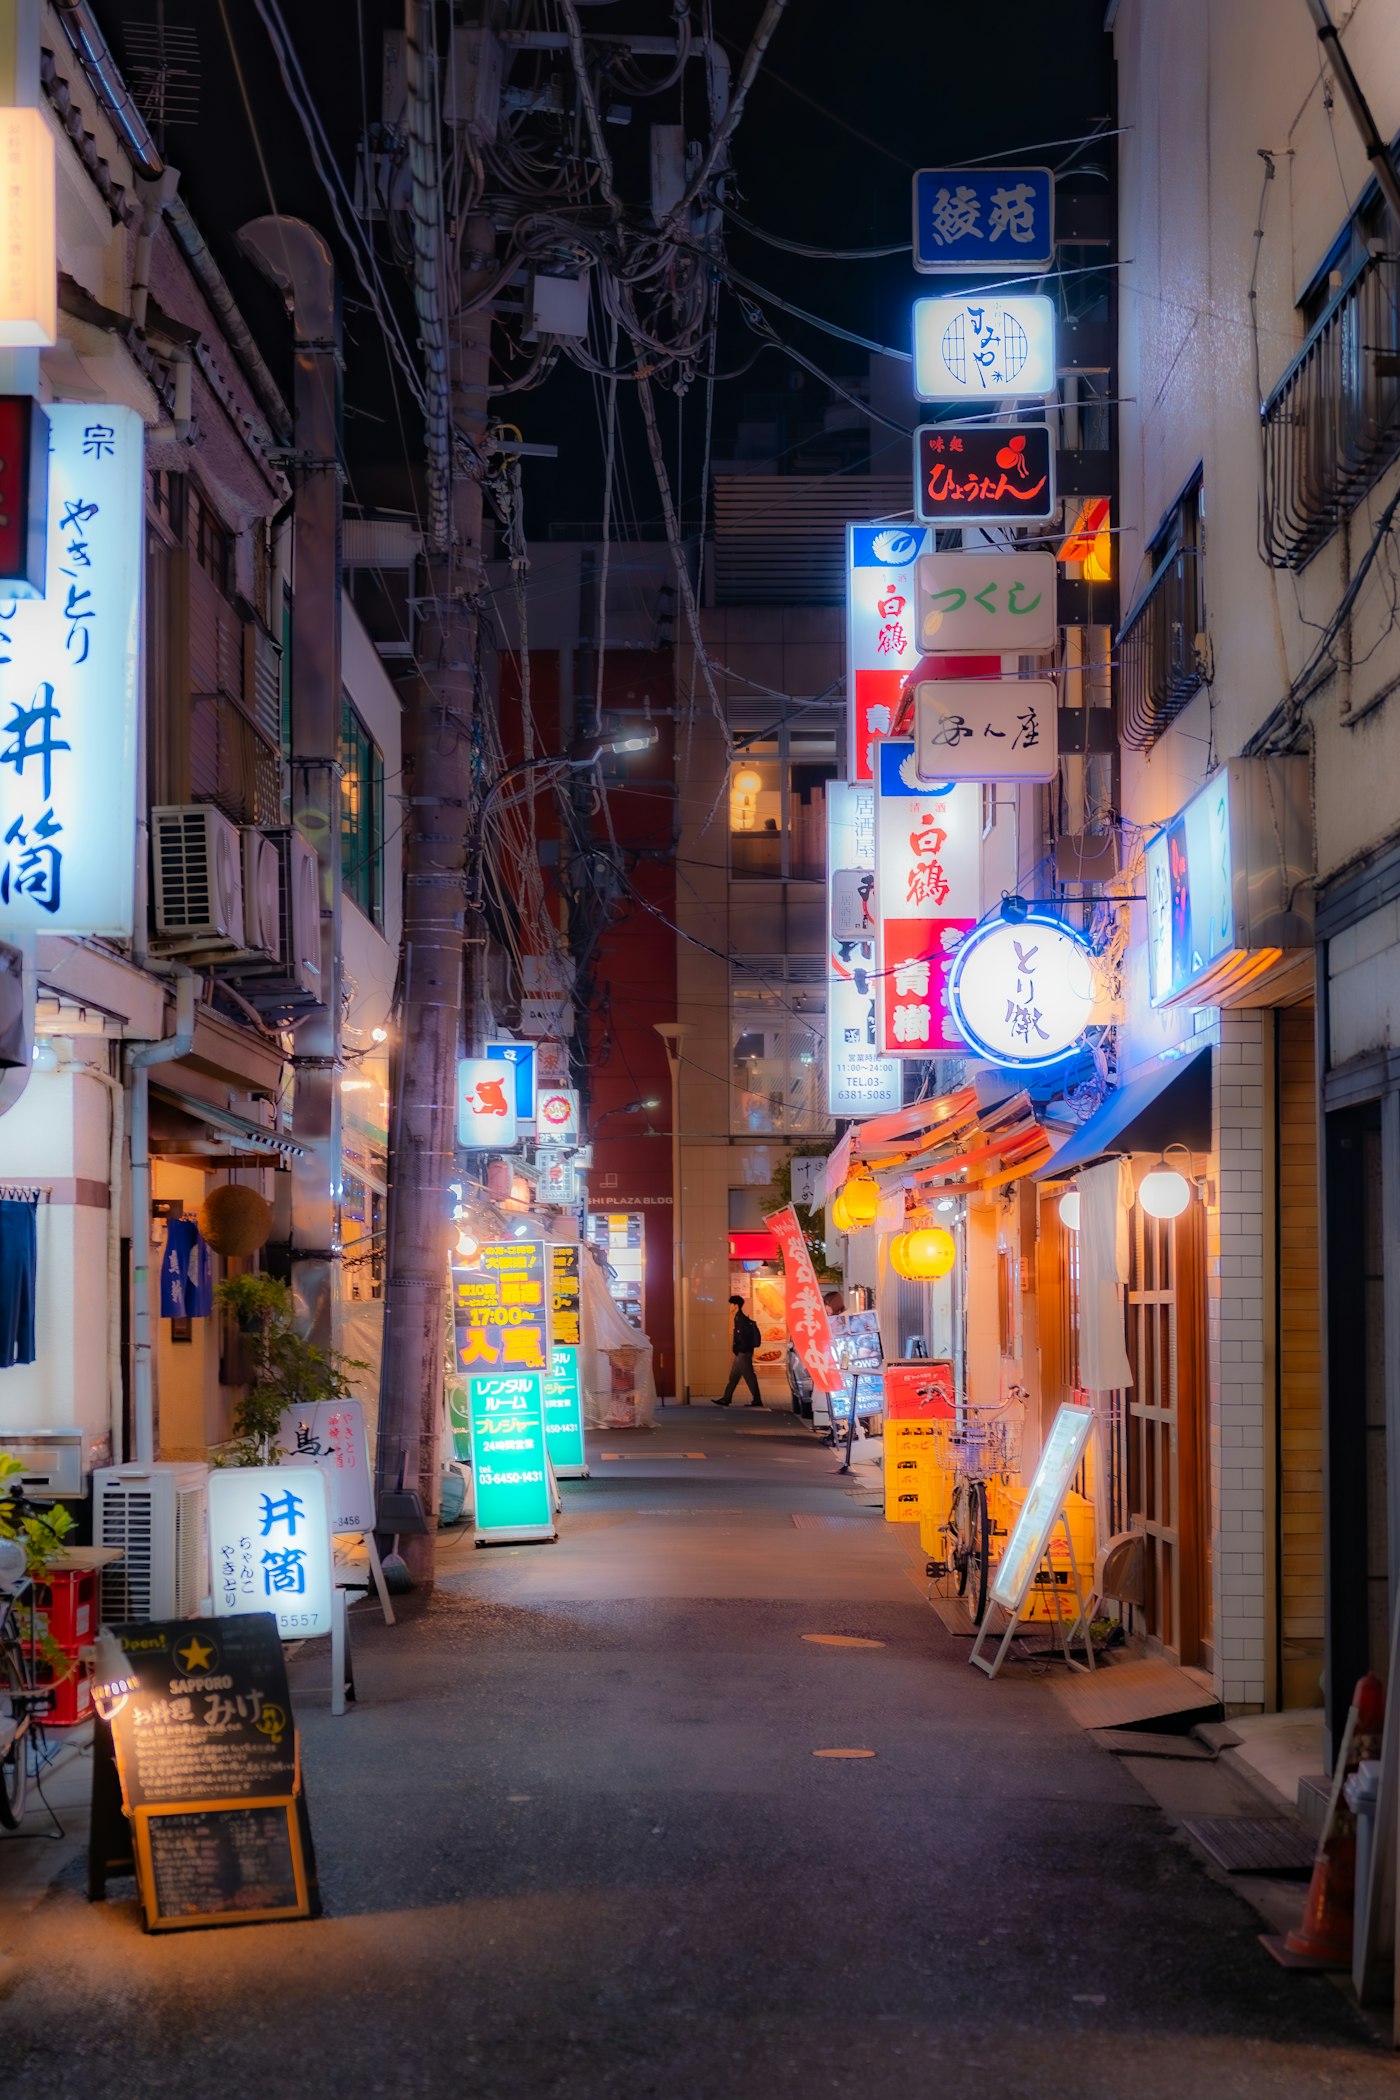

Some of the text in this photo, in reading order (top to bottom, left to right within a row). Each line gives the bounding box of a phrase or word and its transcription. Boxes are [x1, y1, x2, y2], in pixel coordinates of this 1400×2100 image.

[932, 184, 1036, 246] 綾苑
[928, 463, 1047, 501] ひょうたん
[59, 499, 99, 665] やきとり
[930, 581, 1042, 614] つくし
[0, 682, 71, 913] 井筒
[906, 813, 951, 906] 白鶴
[838, 1090, 892, 1101] 6381-5085
[606, 1197, 641, 1205] PLAZA
[477, 1379, 533, 1395] レンタル
[485, 1396, 528, 1411] ルーム
[475, 1418, 540, 1435] プレジャー
[483, 1439, 534, 1452] 24時間営業
[479, 1471, 543, 1486] 03-6450-1431
[258, 1489, 307, 1597] 井筒
[220, 1545, 237, 1609] やきとり
[239, 1536, 255, 1594] ちゃんこ
[279, 1613, 320, 1629] 5557
[169, 1675, 233, 1695] SAPPORO
[203, 1689, 265, 1726] みけ
